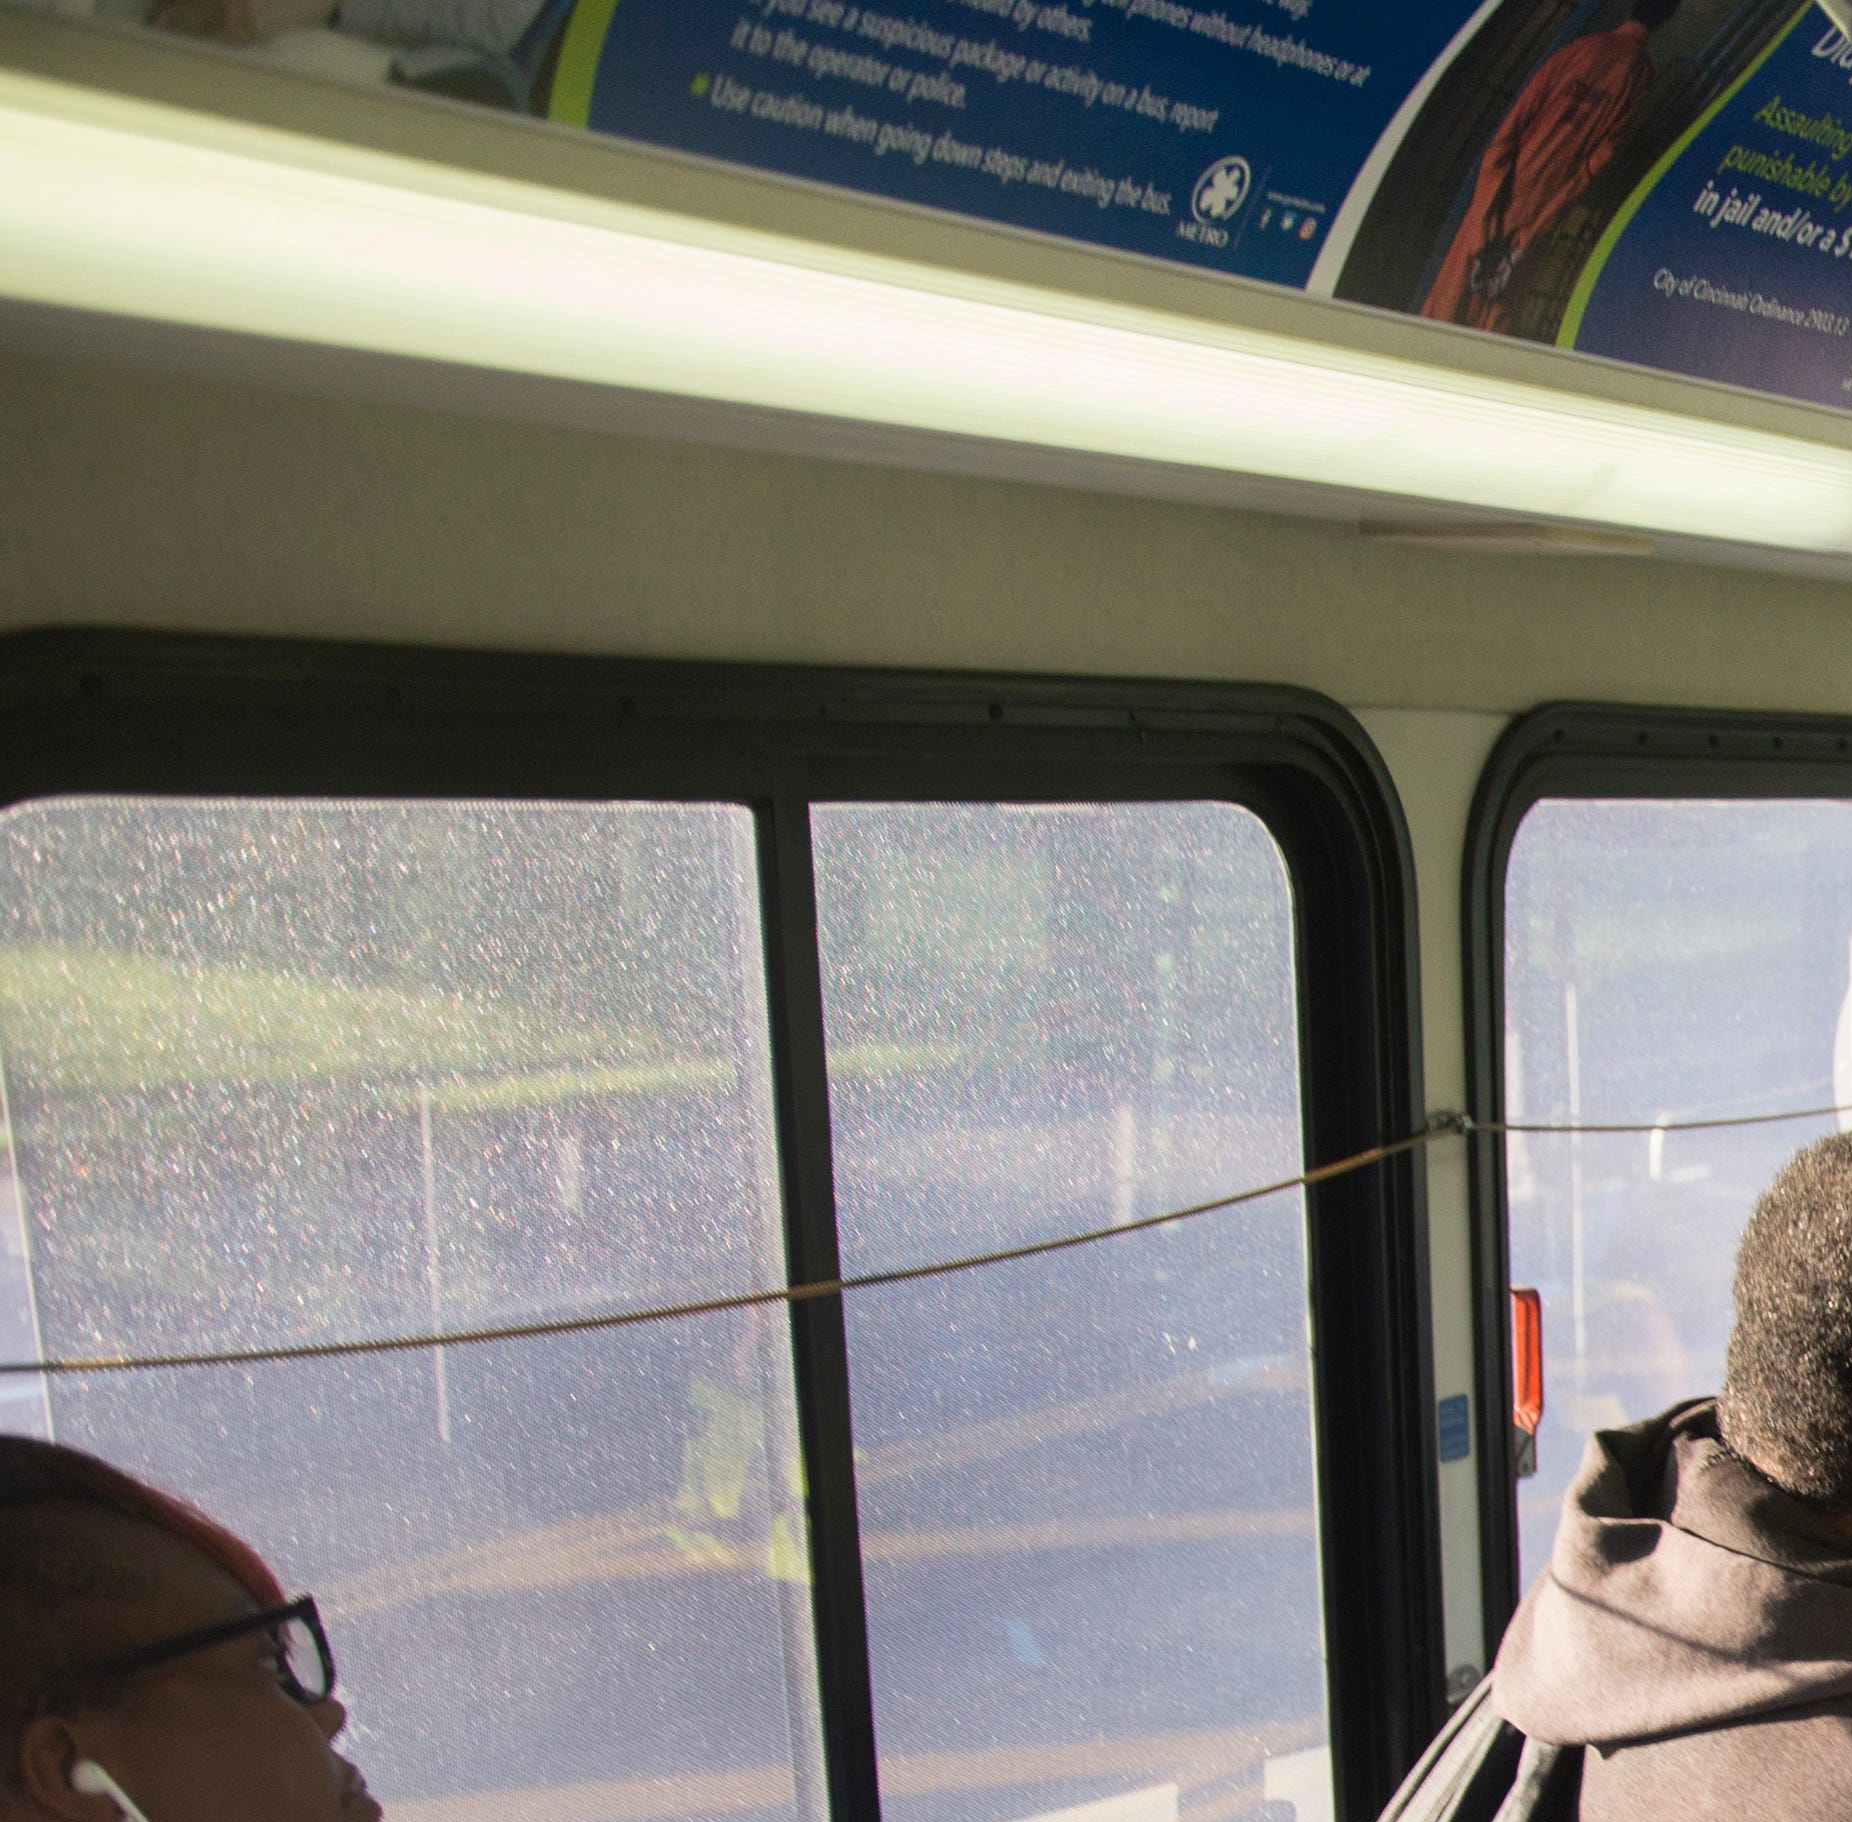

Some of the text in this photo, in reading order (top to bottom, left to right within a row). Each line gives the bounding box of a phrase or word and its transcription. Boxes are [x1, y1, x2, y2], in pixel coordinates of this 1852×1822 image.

[1013, 0, 1038, 32] by
[1190, 10, 1250, 47] without
[1247, 22, 1337, 77] headphones
[1334, 57, 1356, 81] or
[1350, 64, 1371, 87] at
[749, 25, 773, 57] to
[772, 28, 809, 67] the
[808, 43, 890, 87] operator
[887, 68, 912, 93] or
[805, 0, 845, 27] see
[843, 7, 859, 31] a
[857, 10, 953, 60] suspicious
[949, 36, 1027, 84] package
[1025, 58, 1048, 84] or
[1043, 62, 1101, 108] activity
[1101, 79, 1127, 106] on
[1123, 86, 1138, 112] a
[1168, 99, 1219, 133] report
[711, 73, 750, 114] Use
[752, 91, 825, 131] caution
[824, 104, 878, 144] when
[873, 123, 933, 165] going
[931, 129, 982, 169] down
[981, 144, 1027, 185] steps
[1026, 158, 1064, 190] and
[1060, 167, 1116, 209] exiting
[1114, 175, 1144, 207] the
[1717, 145, 1832, 198] punishable
[1176, 220, 1229, 249] METRO
[1693, 179, 1720, 216] in
[1709, 186, 1762, 229] jail
[1751, 207, 1825, 249] and/or
[1818, 228, 1838, 253] a
[1653, 267, 1679, 298] City
[1677, 275, 1699, 297] of
[1692, 278, 1749, 311] Cincinnati
[1749, 291, 1804, 326] Ordinance
